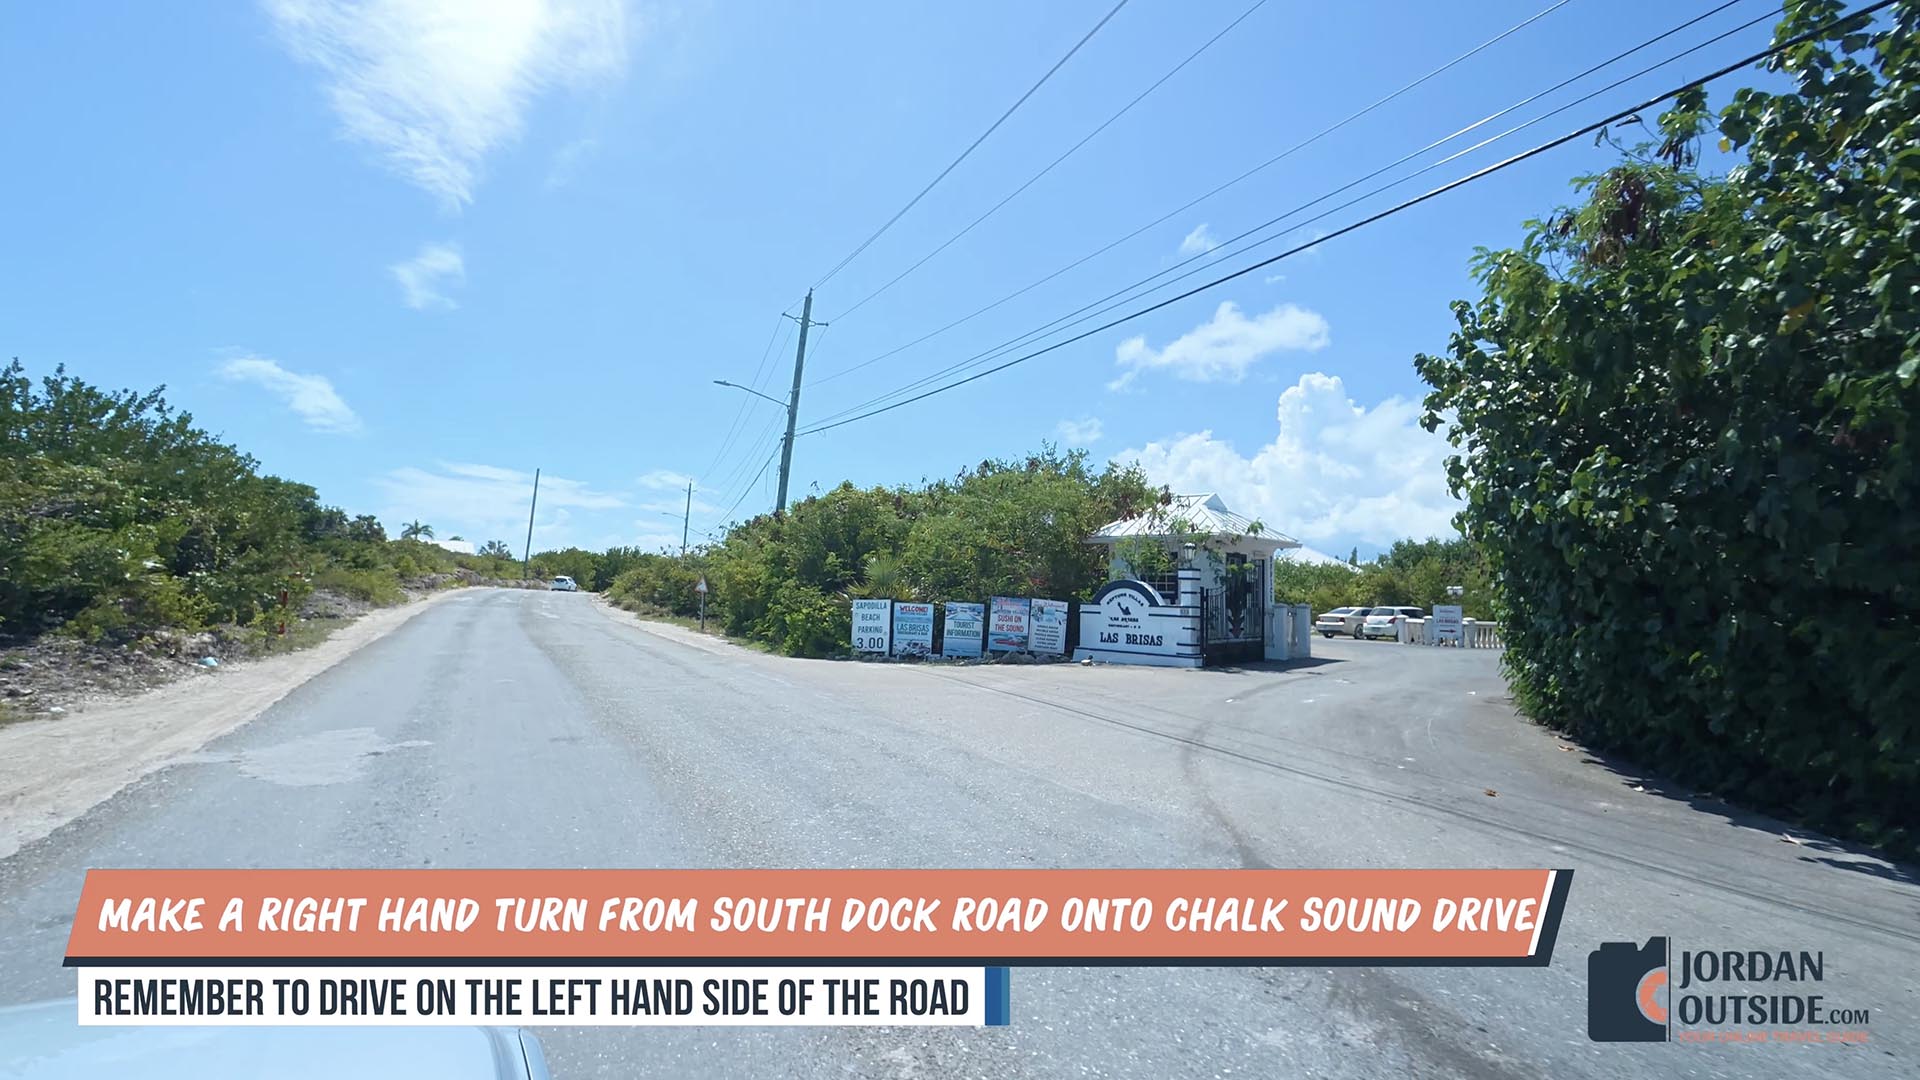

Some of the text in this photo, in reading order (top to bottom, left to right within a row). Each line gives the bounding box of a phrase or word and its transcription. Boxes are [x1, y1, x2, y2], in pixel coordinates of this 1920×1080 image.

[855, 602, 887, 610] SAPODILLA
[861, 613, 880, 622] BEACH
[997, 614, 1022, 623] SUSHI ON
[857, 625, 883, 634] PARKING
[896, 623, 930, 632] LAS BRISAS
[953, 621, 975, 629] TOURIST
[995, 624, 1024, 633] THE SOUND
[946, 629, 980, 638] INFORMATION
[856, 637, 884, 649] 3.00
[1099, 632, 1163, 647] LAS BRISAS
